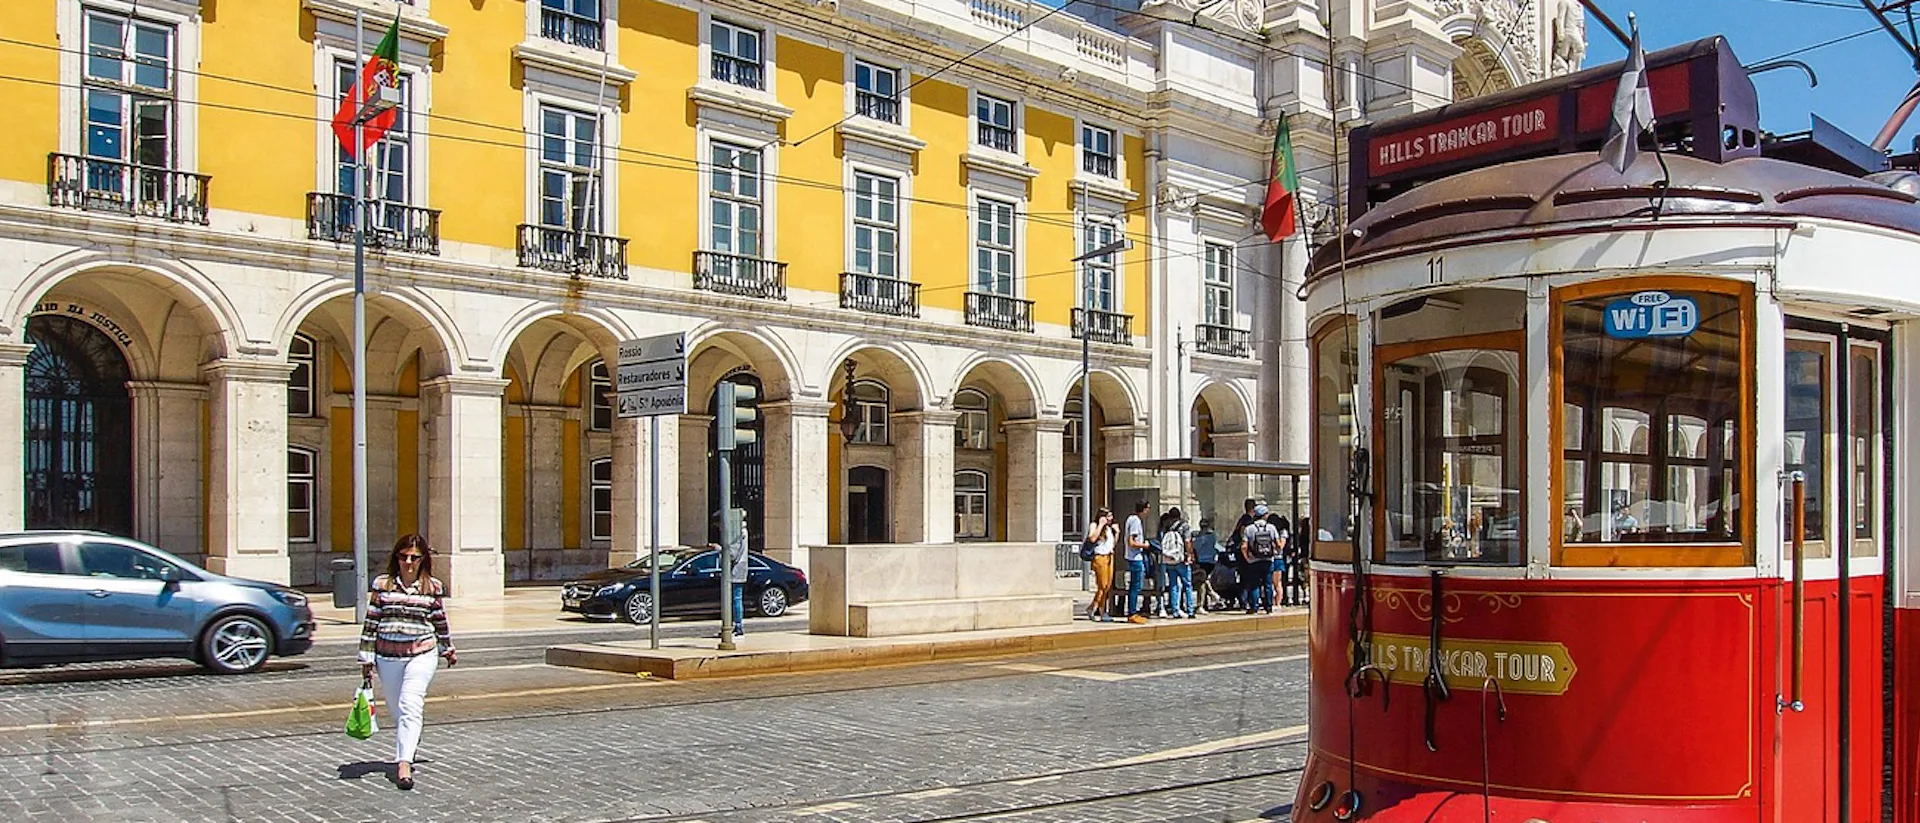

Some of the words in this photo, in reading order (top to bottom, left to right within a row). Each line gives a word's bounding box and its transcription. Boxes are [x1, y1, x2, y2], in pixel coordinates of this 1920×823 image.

[1379, 137, 1424, 166] HILLS
[1428, 120, 1498, 155] TRAMCAR
[1501, 109, 1547, 139] TOUR
[1426, 256, 1443, 284] 11
[1638, 294, 1663, 304] FREE
[67, 304, 84, 315] DA
[619, 345, 642, 358] Rossio
[618, 369, 671, 385] Restauradores
[1494, 652, 1556, 683] TOUR
